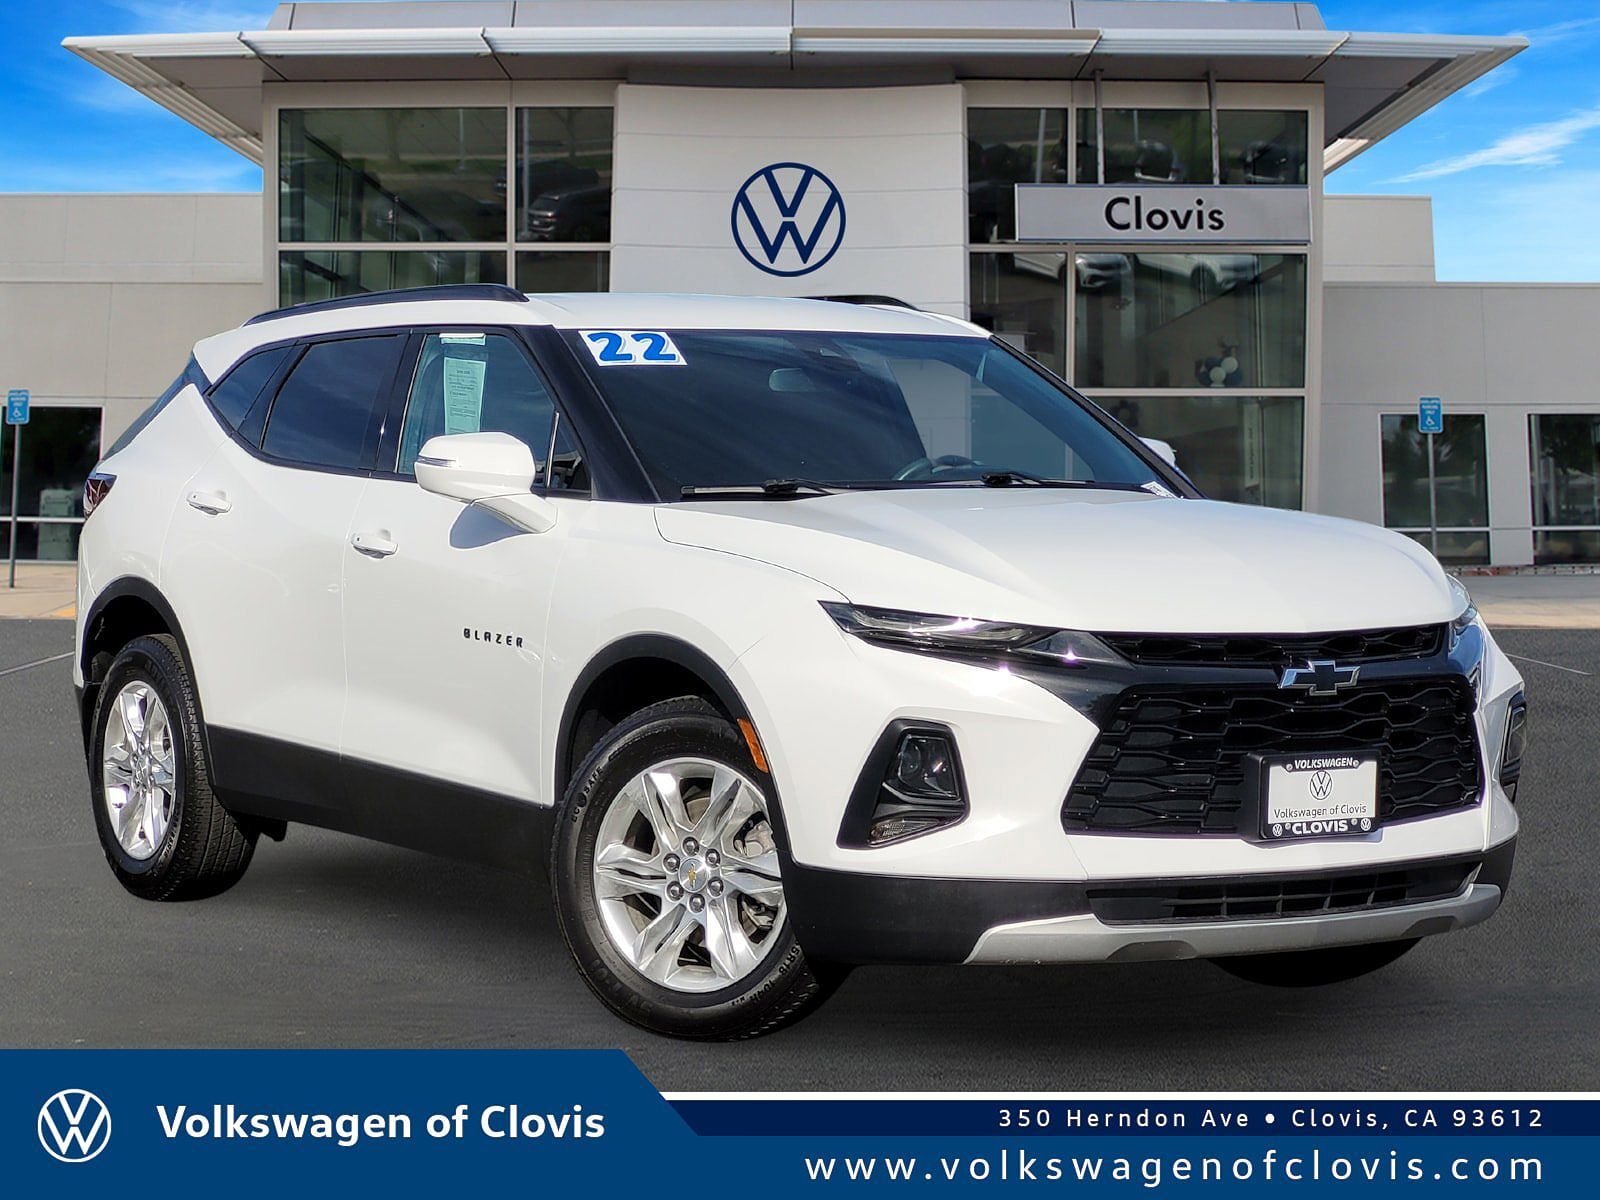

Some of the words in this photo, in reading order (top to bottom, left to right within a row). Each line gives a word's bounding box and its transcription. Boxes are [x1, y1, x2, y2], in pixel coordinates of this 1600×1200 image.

[1104, 195, 1225, 231] Clovis
[586, 331, 677, 362] 22
[463, 627, 523, 648] BLAZER
[1294, 757, 1353, 769] VOLKSWAGEN
[1274, 807, 1327, 819] Volkswagen
[1329, 804, 1340, 815] of
[1340, 803, 1367, 814] Clovis
[1292, 819, 1349, 835] CLOVIS
